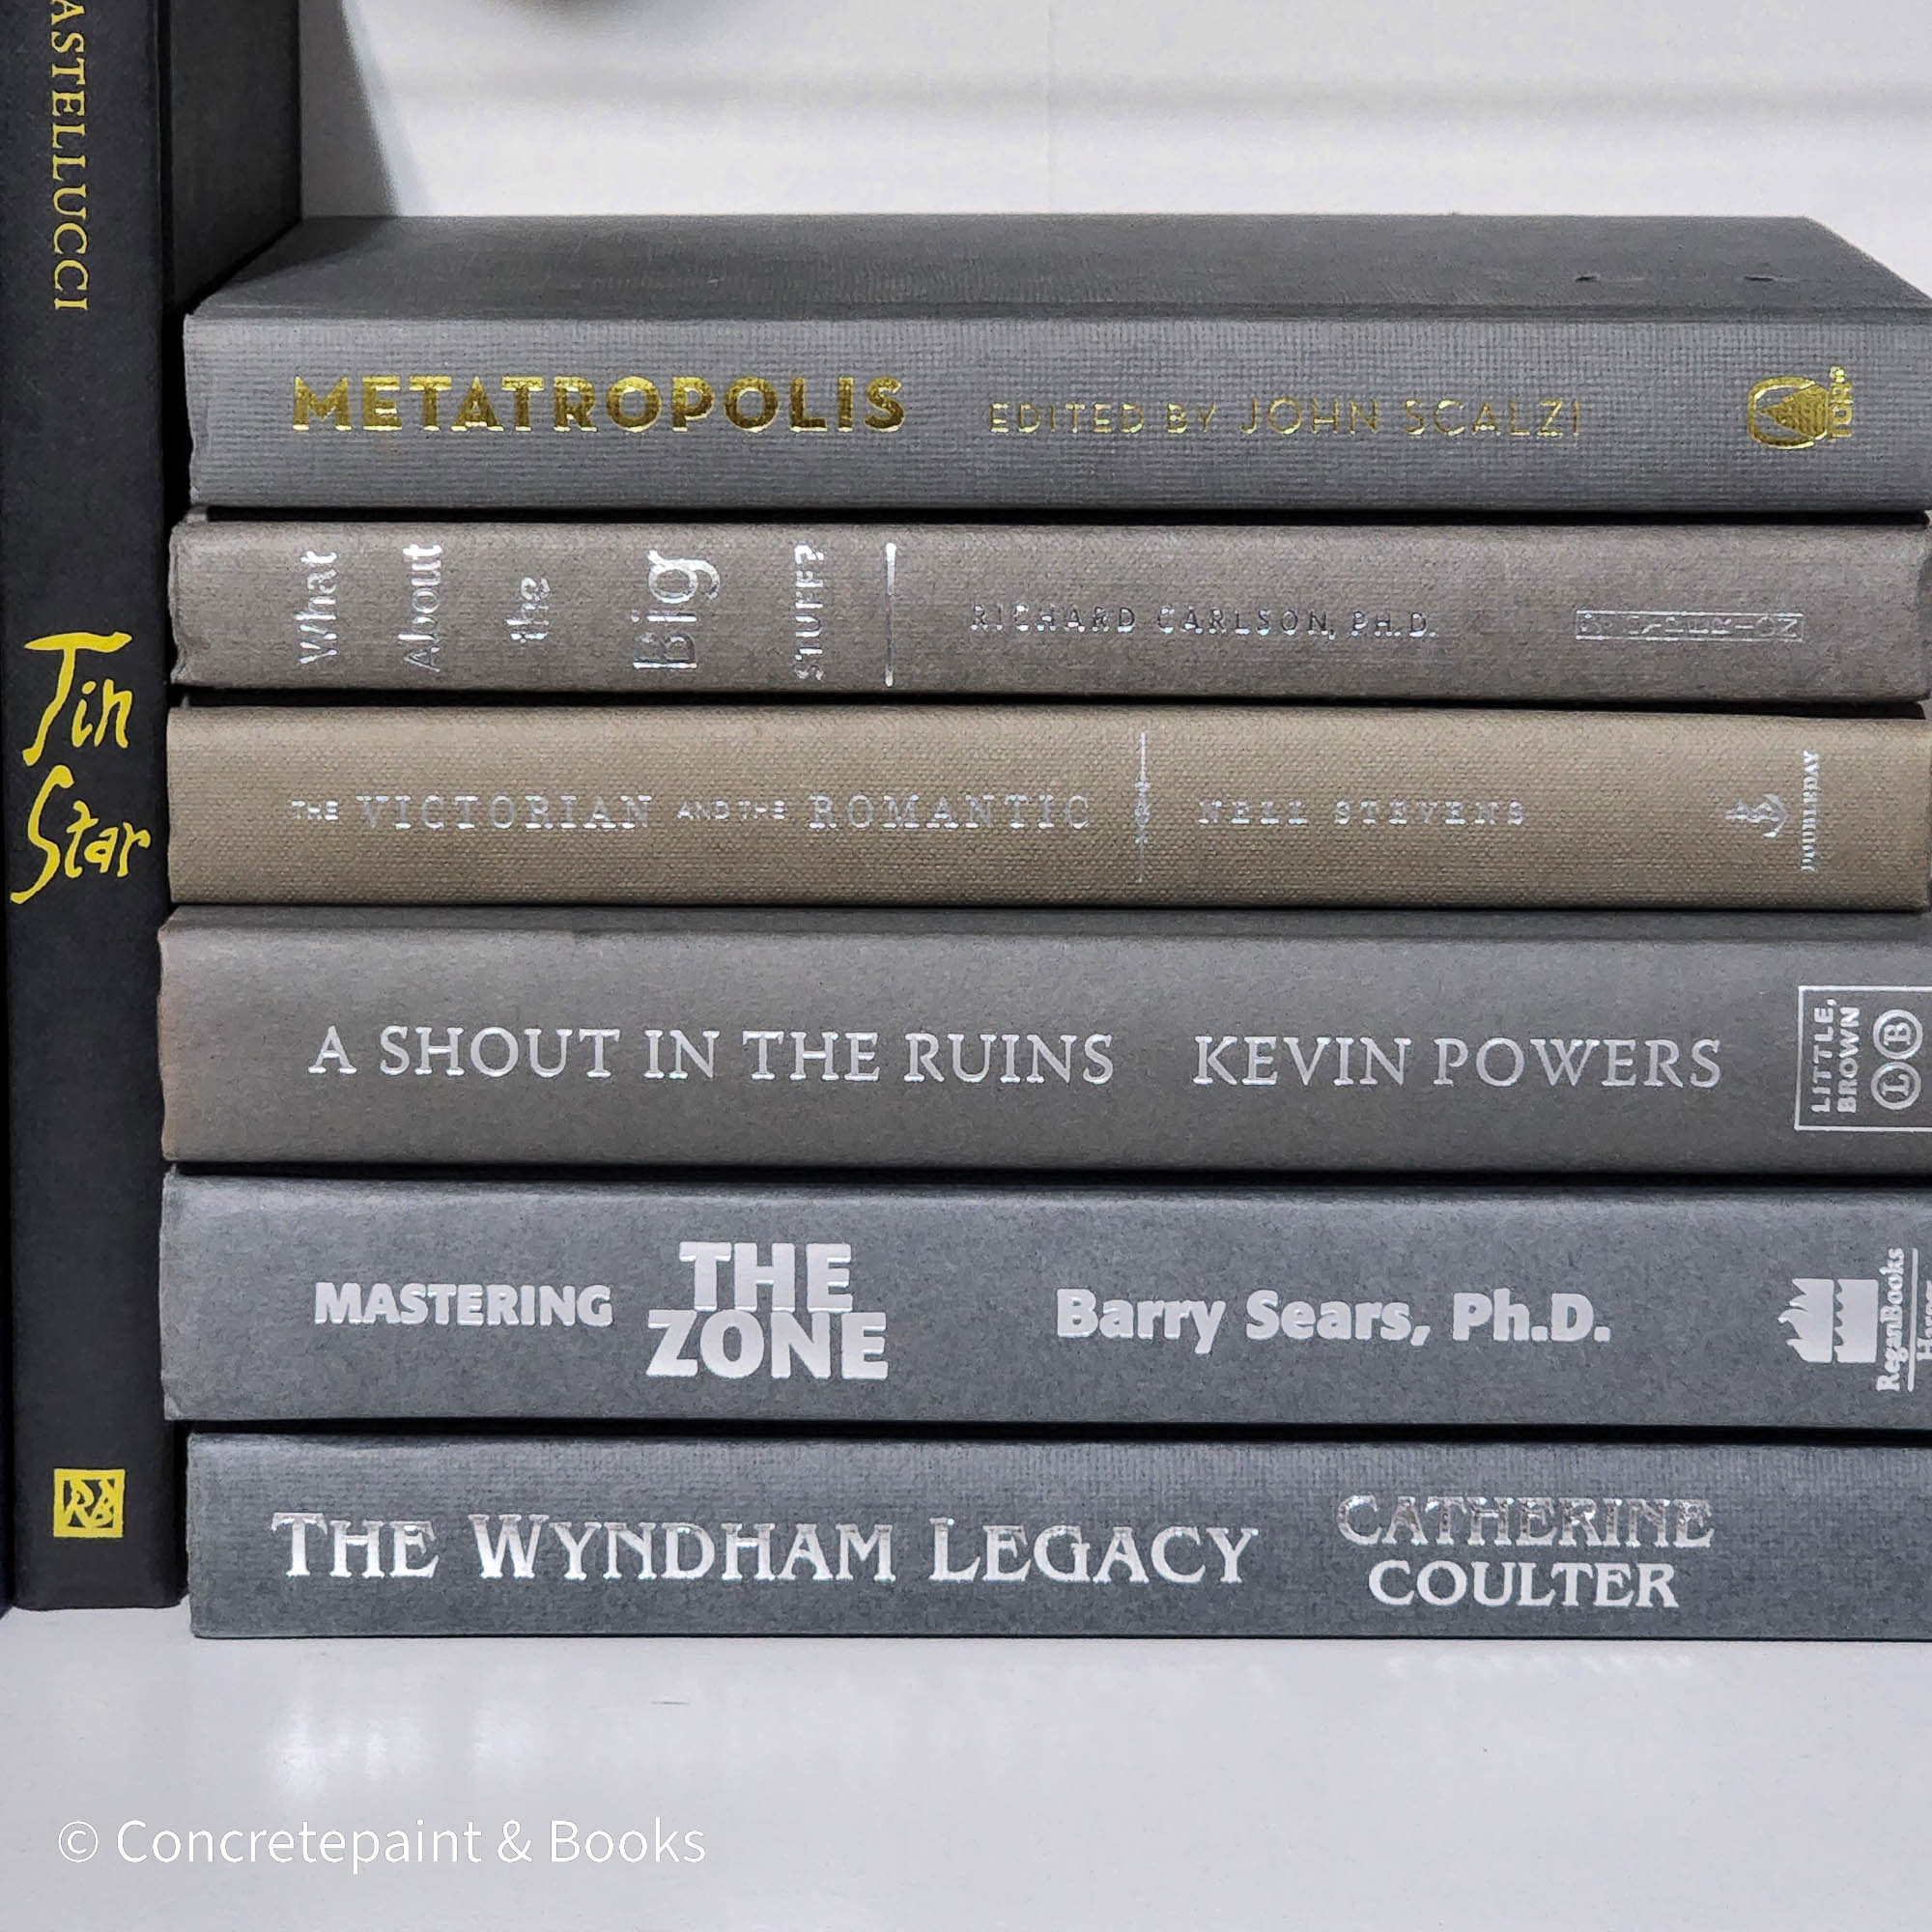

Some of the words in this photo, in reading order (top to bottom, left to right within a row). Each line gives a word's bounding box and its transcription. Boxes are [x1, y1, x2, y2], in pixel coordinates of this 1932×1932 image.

[292, 375, 906, 433] METATROPOLIS
[989, 402, 1145, 434] EDITED
[1166, 402, 1217, 435] BY
[1239, 397, 1379, 437] JOHN
[1401, 399, 1581, 438] SCALZI
[293, 550, 338, 665] What
[397, 543, 442, 673] About
[504, 577, 551, 644] the
[630, 549, 721, 670] Big
[970, 604, 1136, 634] RICHARD
[1158, 606, 1337, 640] CARLSON,
[1351, 610, 1438, 639] PH.D.
[22, 631, 133, 767] Tin
[9, 764, 151, 905] Star
[291, 799, 339, 821] THE
[355, 795, 653, 830] VICTORIAN
[677, 800, 731, 821] AND
[737, 800, 785, 821] THE
[809, 794, 1090, 830] ROMANTIC
[1198, 800, 1310, 826] NELL
[1333, 801, 1524, 827] STEVENS
[308, 1026, 359, 1076] A
[378, 1025, 620, 1080] SHOUT
[644, 1029, 720, 1080] IN
[742, 1031, 880, 1083] THE
[903, 1033, 1115, 1086] RUINS
[1192, 1036, 1413, 1087] KEVIN
[1433, 1037, 1722, 1090] POWERS
[1810, 999, 1837, 1113] LITTLE,
[1836, 1006, 1861, 1114] BROWN
[314, 1281, 614, 1327] MASTERING
[679, 1240, 854, 1313] THE
[646, 1309, 890, 1379] ZONE
[1056, 1288, 1226, 1354] Barry
[1245, 1290, 1431, 1347] Sears,
[1452, 1288, 1611, 1342] Ph.D.
[1876, 1247, 1910, 1392] ReganBooks
[270, 1512, 440, 1579] THE
[468, 1514, 896, 1583] WYNDHAM
[928, 1517, 1260, 1585] LEGACY
[1337, 1494, 1716, 1548] CATHERINE
[1368, 1559, 1680, 1608] COULTER
